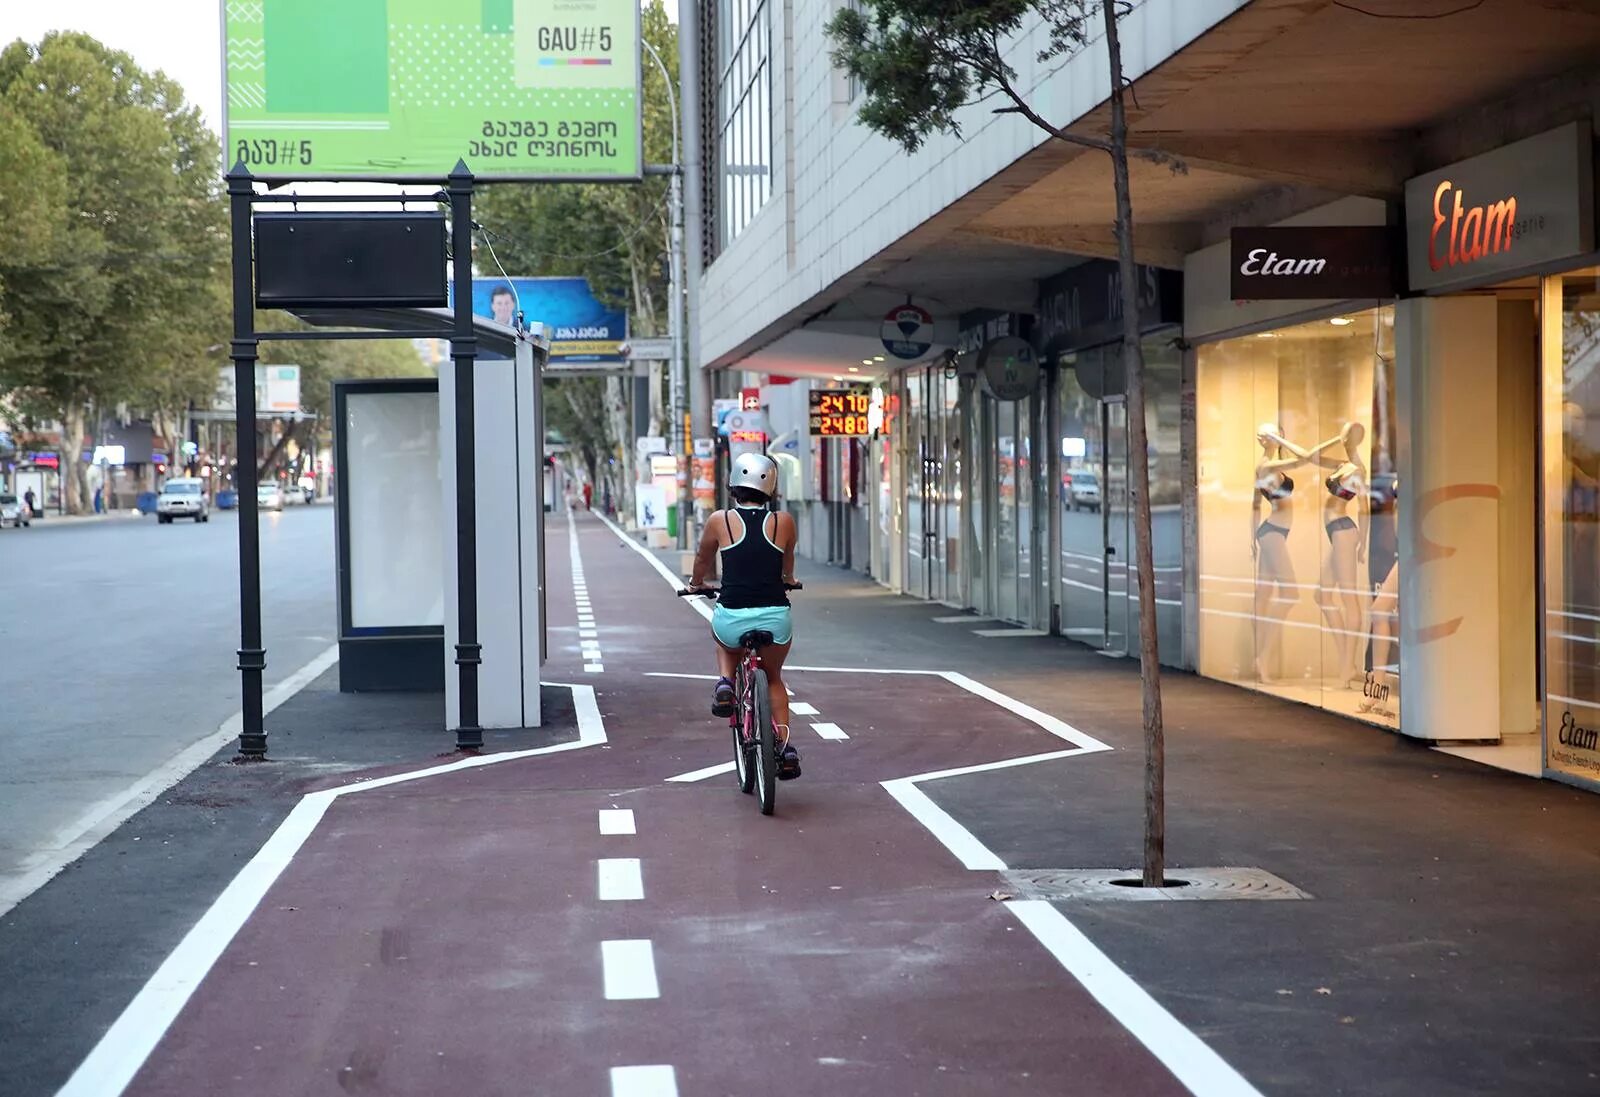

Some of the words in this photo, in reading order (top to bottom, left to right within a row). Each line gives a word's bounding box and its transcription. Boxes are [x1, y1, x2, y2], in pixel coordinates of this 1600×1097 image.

[538, 26, 612, 52] GAU#5
[482, 121, 548, 138] გაუგე
[557, 121, 617, 138] გემო
[469, 140, 518, 157] ახალ
[527, 140, 617, 157] ღვინოს
[1428, 181, 1518, 273] Etam
[1240, 248, 1326, 276] Etam
[1363, 671, 1390, 702] Etam
[1559, 711, 1598, 751] Etam
